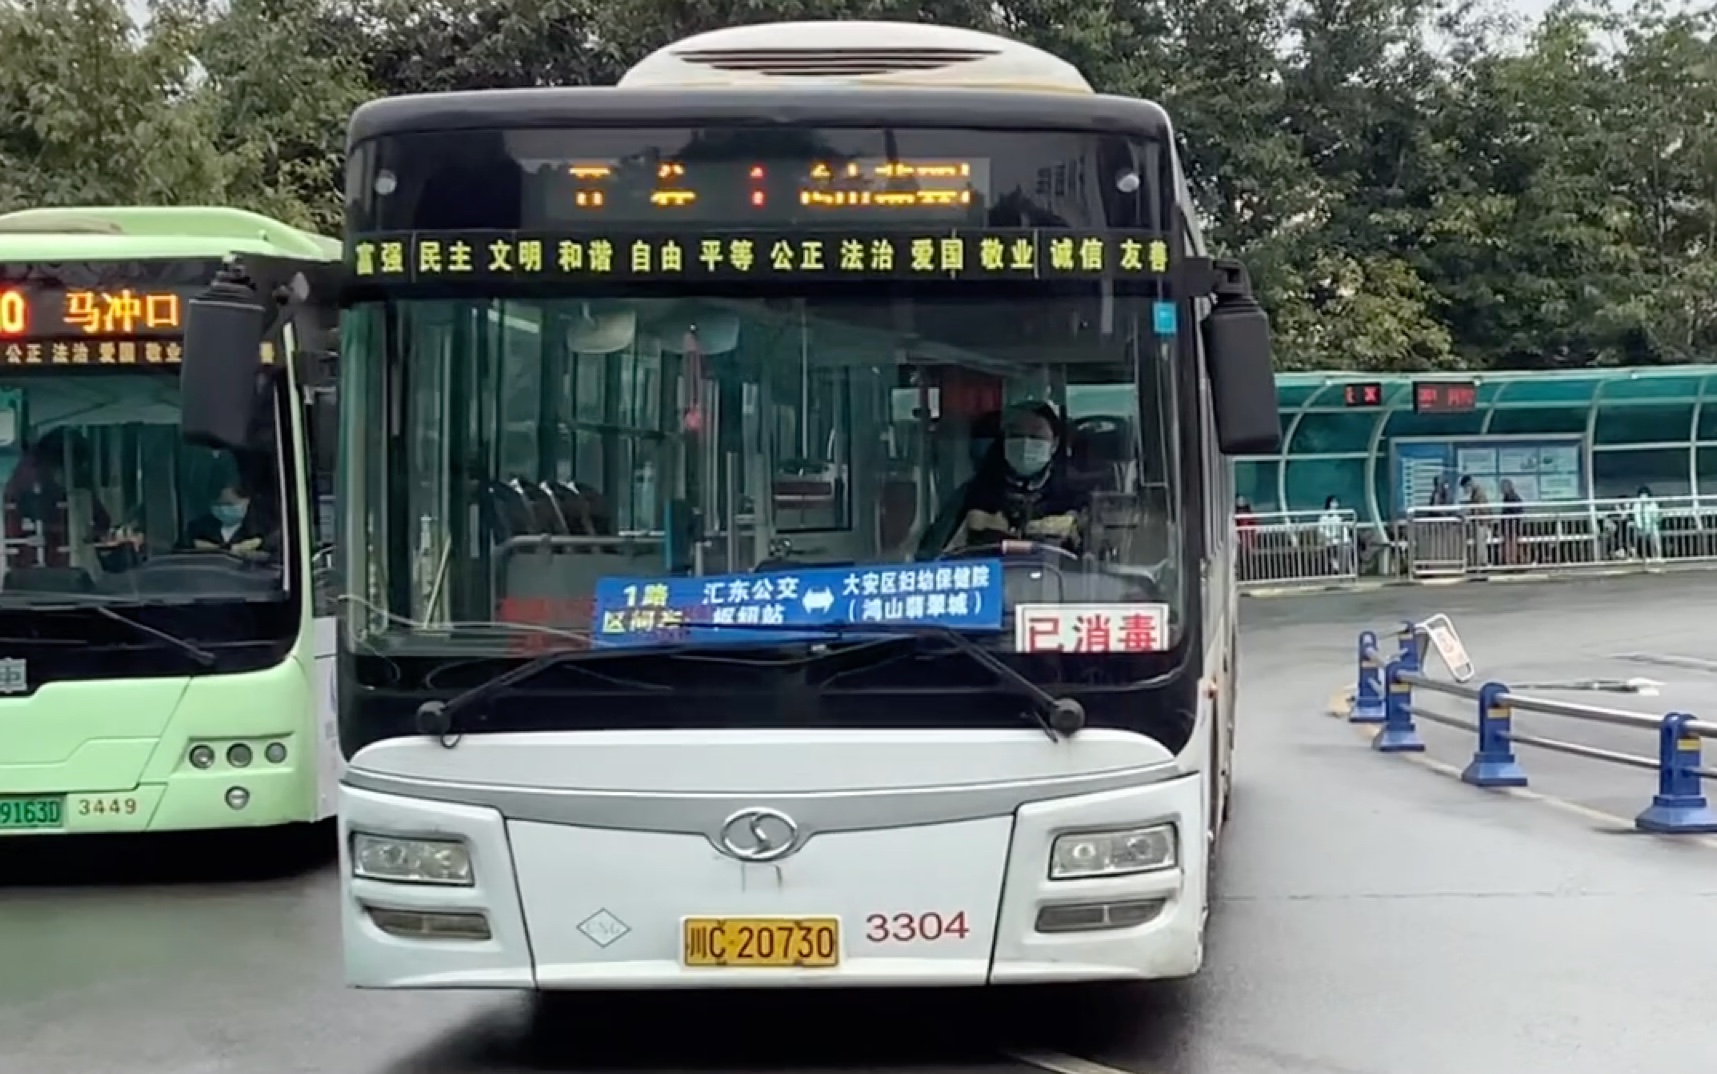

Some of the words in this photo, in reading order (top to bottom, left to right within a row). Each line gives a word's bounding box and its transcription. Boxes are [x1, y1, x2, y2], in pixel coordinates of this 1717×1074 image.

[355, 242, 403, 275] 富强
[419, 240, 472, 272] 民主
[488, 239, 543, 272] 文明
[558, 240, 612, 272] 和谐
[631, 240, 683, 272] 自由
[699, 240, 754, 272] 平等
[769, 239, 825, 270] 公正
[839, 239, 895, 270] 法治
[910, 239, 965, 271] 爱国
[980, 238, 1034, 270] 敬业
[1050, 238, 1103, 270] 诚信
[1120, 239, 1168, 272] 友善
[63, 289, 178, 333] 马冲口
[6, 343, 42, 363] 公正
[52, 342, 89, 363] 法治
[702, 576, 799, 604] 汇东公交
[842, 565, 990, 595] 大安区妇幼保健院
[624, 584, 668, 607] 1路
[1029, 614, 1157, 653] 已消毒
[78, 798, 137, 816] 3449
[866, 911, 969, 942] 3304
